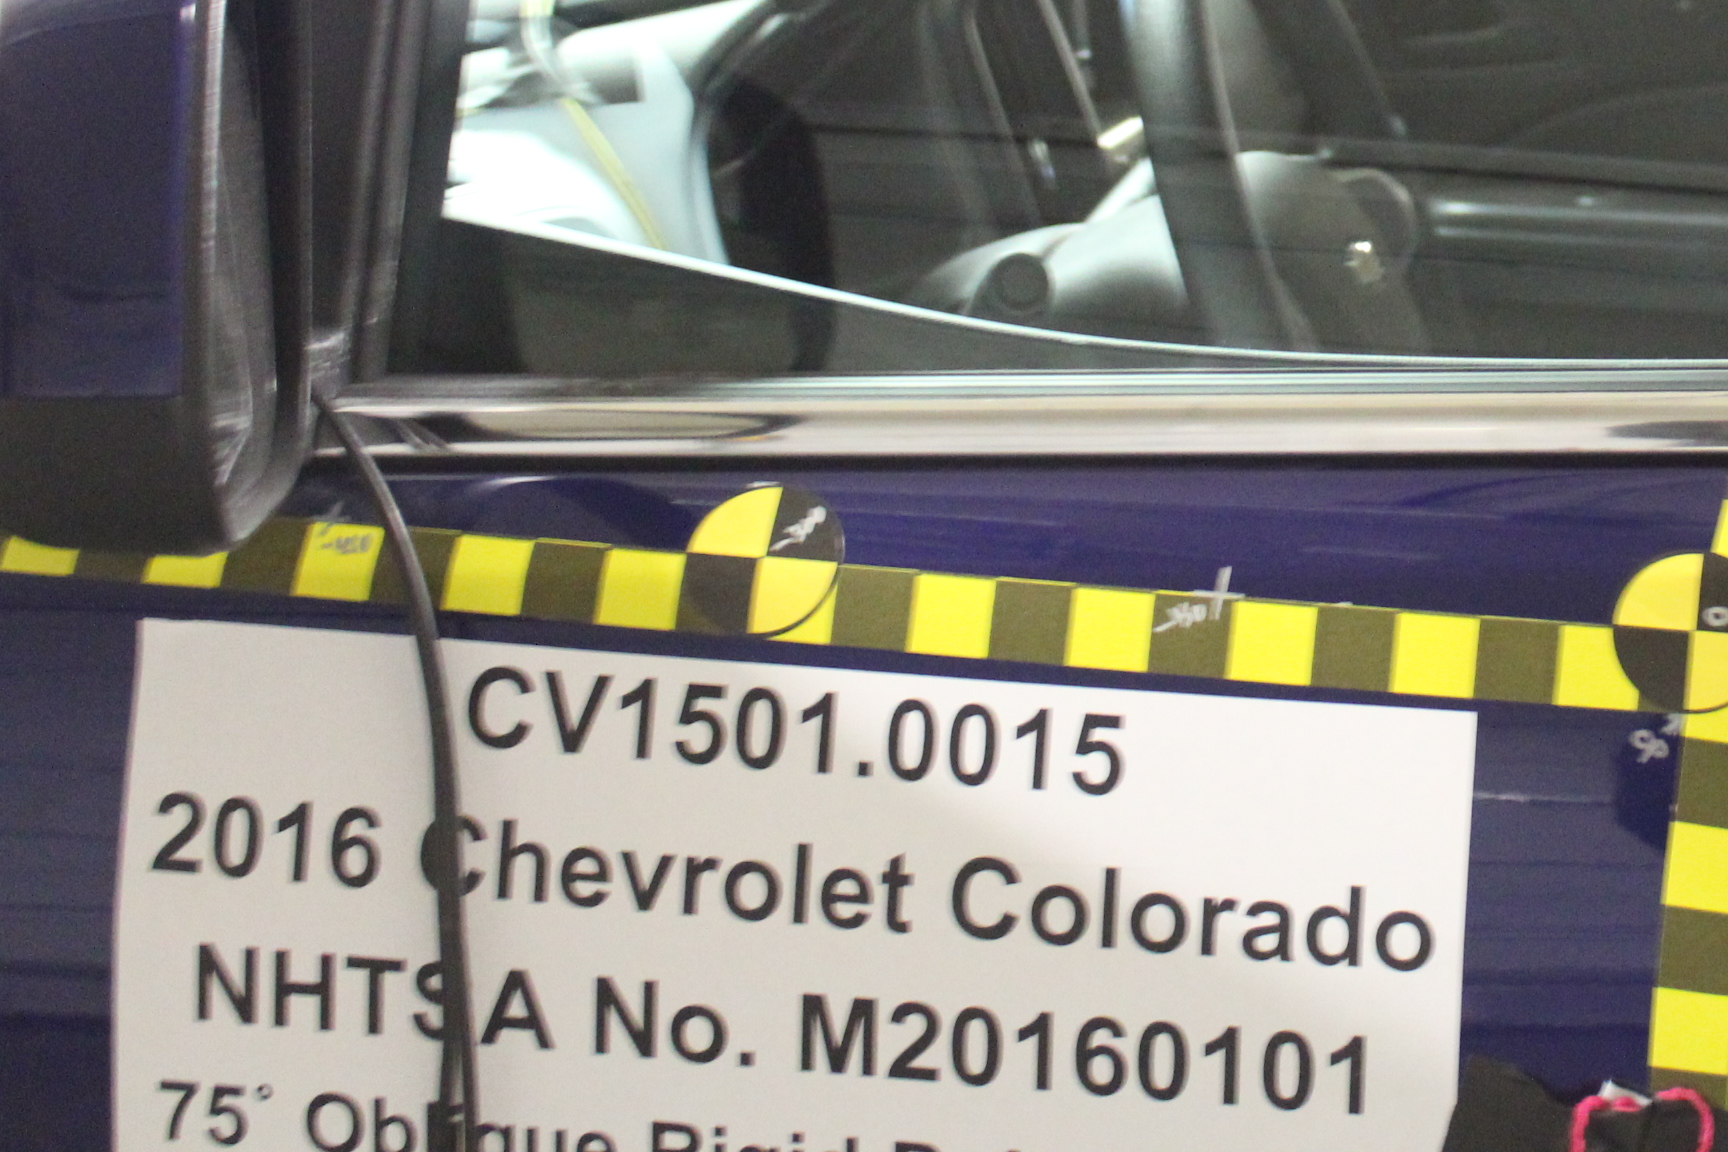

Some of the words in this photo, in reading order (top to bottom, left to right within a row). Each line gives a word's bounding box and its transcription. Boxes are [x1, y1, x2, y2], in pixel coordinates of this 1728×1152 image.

[466, 665, 1127, 797] CV1501.0015
[150, 791, 383, 889] 2016
[420, 815, 914, 935] Chevrolet
[950, 855, 1437, 973] Colorado
[593, 976, 757, 1068] No.
[798, 992, 1370, 1116] M20160101
